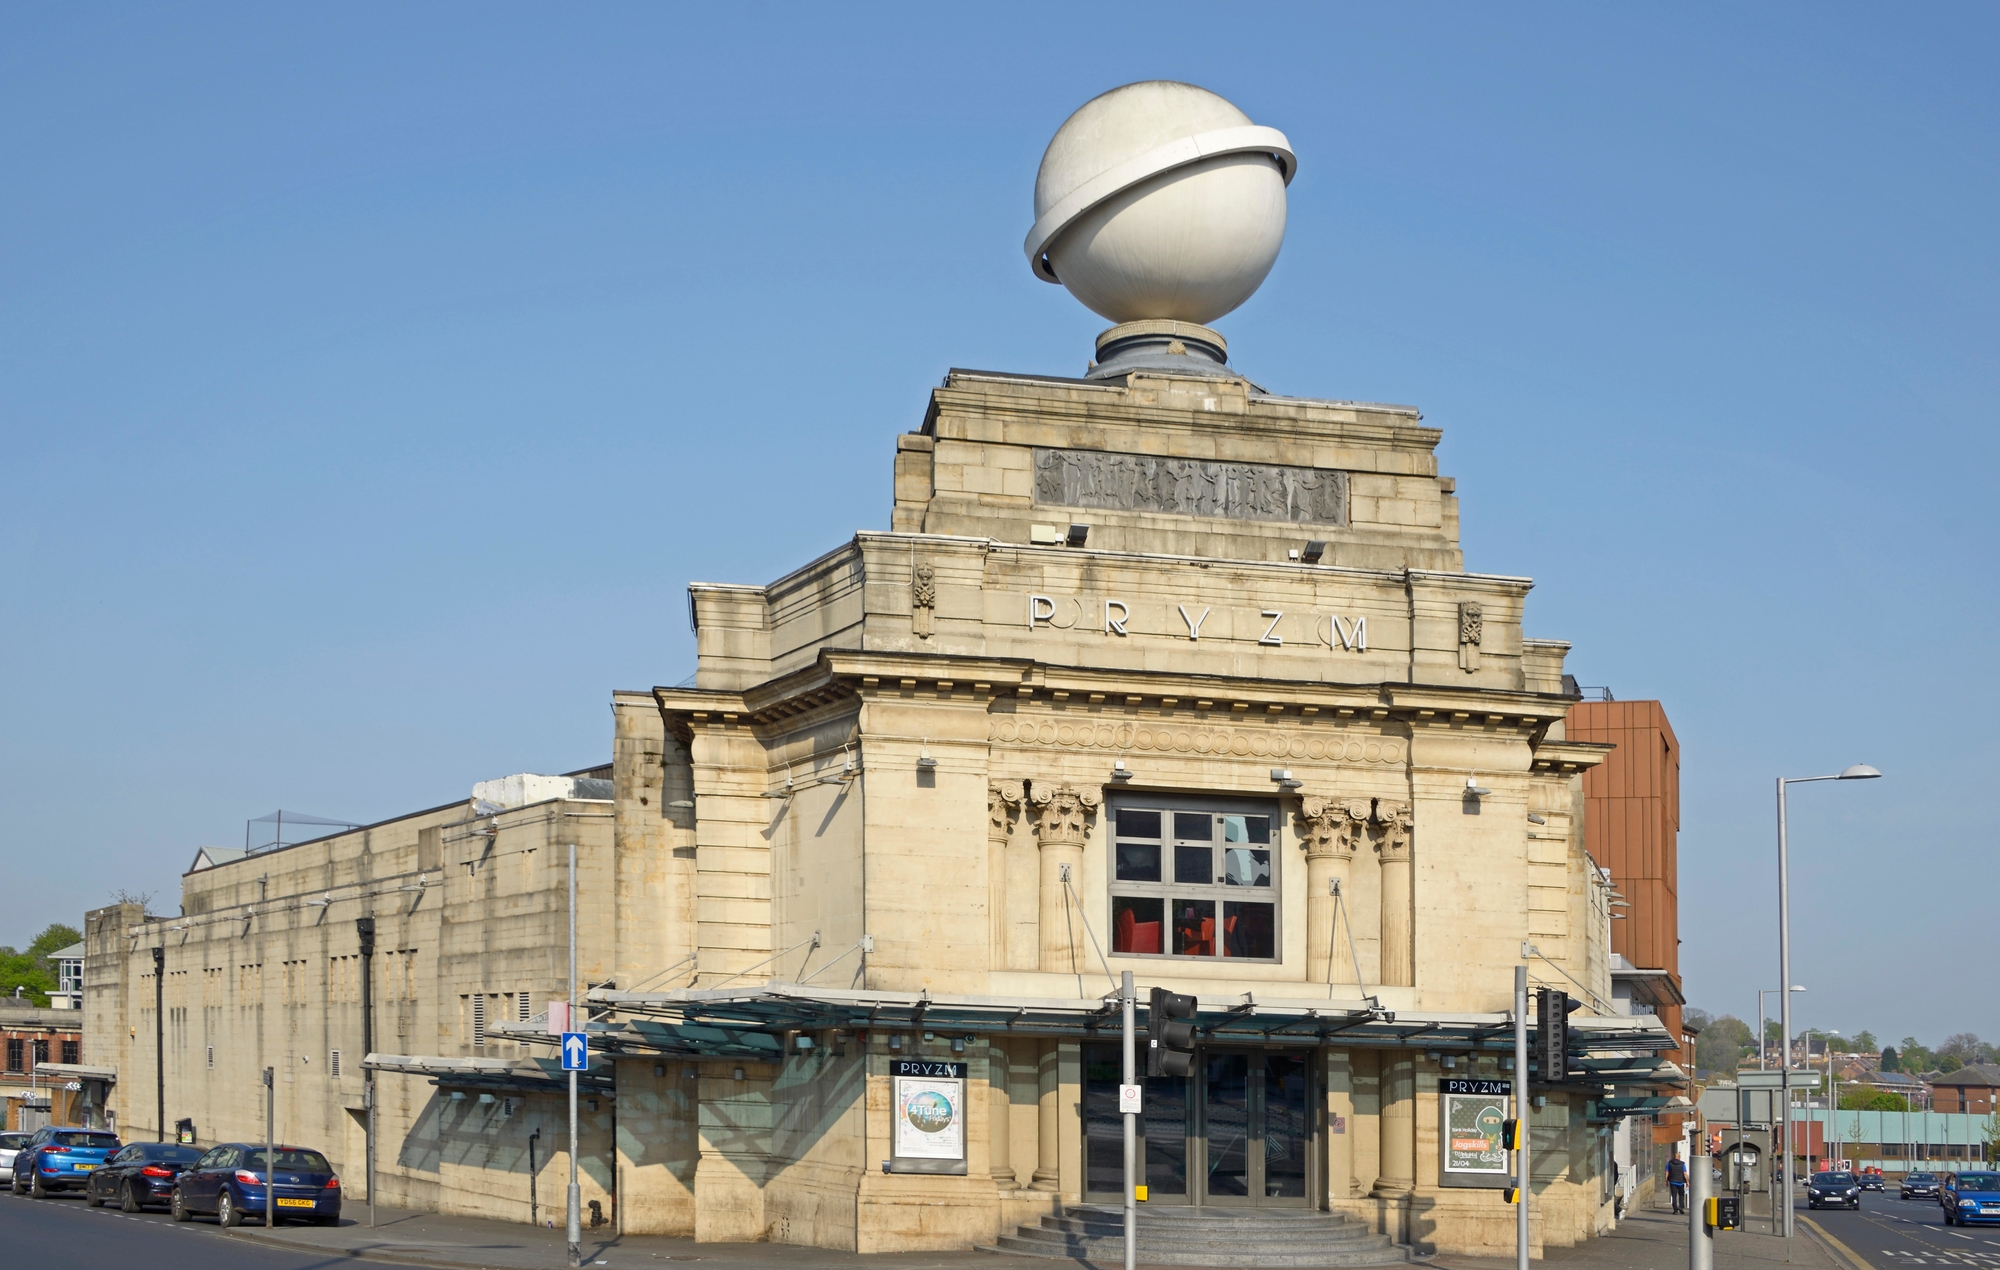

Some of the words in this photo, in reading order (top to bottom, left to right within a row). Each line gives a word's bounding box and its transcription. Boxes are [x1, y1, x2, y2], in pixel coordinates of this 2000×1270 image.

[1029, 594, 1367, 652] PRYZM
[900, 1062, 958, 1076] PRYZM
[1449, 1081, 1501, 1093] PRYZM
[910, 1105, 947, 1116] 4Tune
[1453, 1139, 1487, 1150] Jagskills
